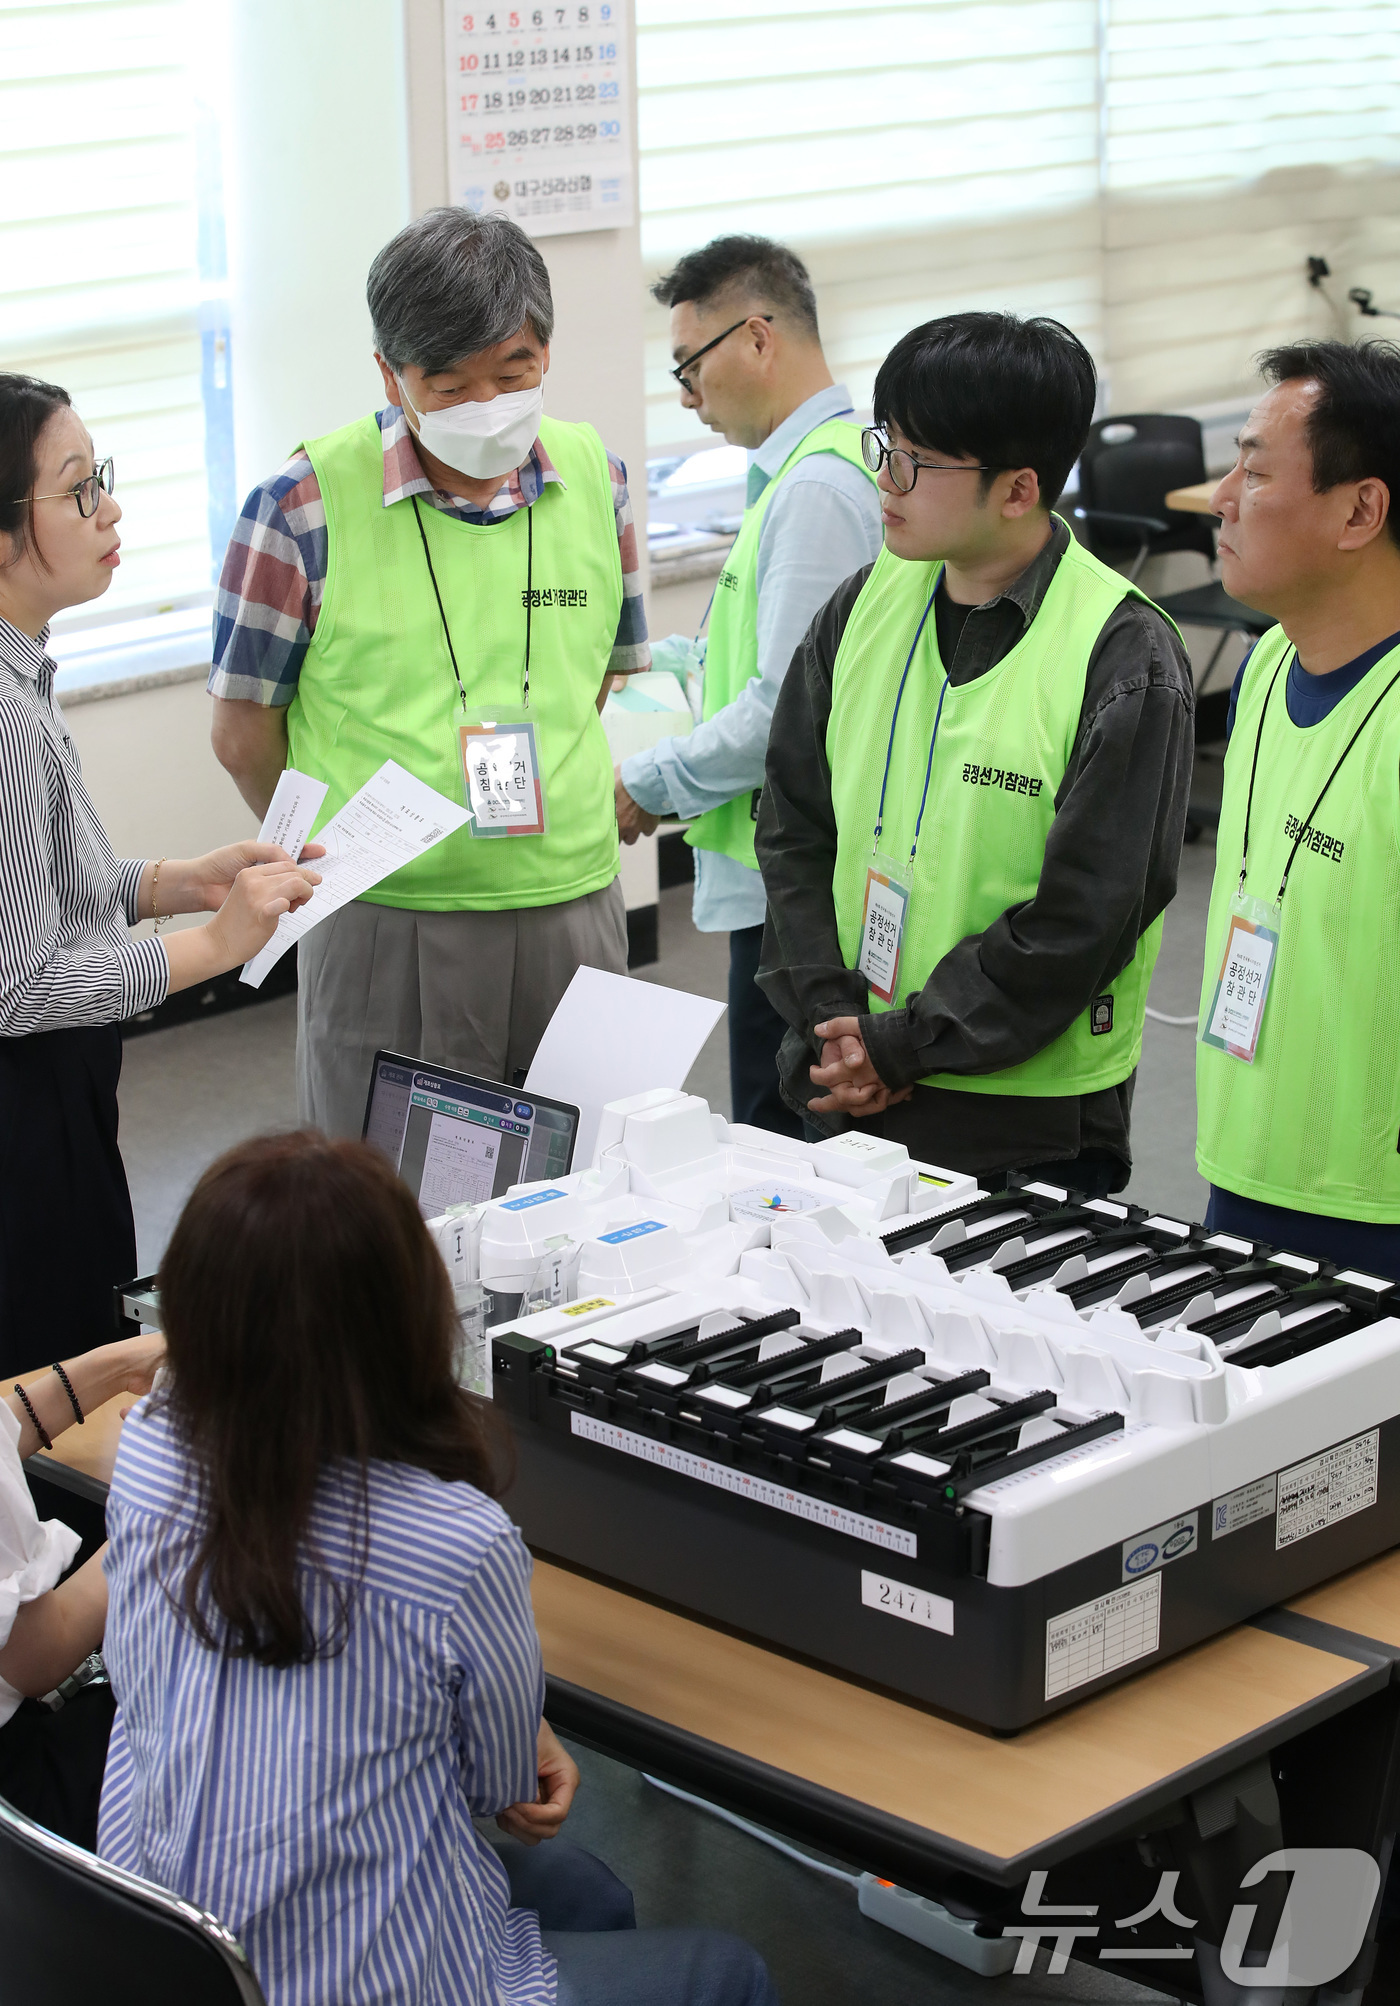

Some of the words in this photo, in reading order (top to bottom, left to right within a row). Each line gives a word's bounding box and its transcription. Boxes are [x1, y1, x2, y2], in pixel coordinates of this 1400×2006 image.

[463, 15, 474, 32] 3
[487, 14, 496, 29] 4
[509, 12, 520, 28] 5
[532, 11, 543, 26] 6
[555, 9, 565, 24] 7
[579, 7, 589, 22] 8
[601, 5, 611, 20] 9
[459, 55, 479, 71] 10
[484, 54, 500, 69] 11
[507, 52, 525, 67] 12
[530, 49, 548, 65] 13
[553, 48, 570, 63] 14
[576, 47, 593, 62] 15
[599, 44, 616, 60] 16
[461, 94, 478, 111] 17
[484, 93, 502, 109] 18
[508, 91, 526, 107] 19
[529, 89, 550, 105] 20
[553, 87, 571, 102] 21
[576, 85, 595, 100] 22
[599, 83, 618, 98] 23
[484, 132, 505, 149] 25
[508, 131, 528, 146] 26
[531, 128, 550, 144] 27
[554, 126, 574, 142] 28
[577, 124, 597, 140] 29
[600, 121, 620, 137] 30
[521, 588, 587, 608] 공정선거참관단
[477, 761, 526, 776] 공거
[962, 763, 1043, 797] 공정선거참관단
[870, 909, 897, 938] 공정선거
[1229, 961, 1262, 989] 공정선거
